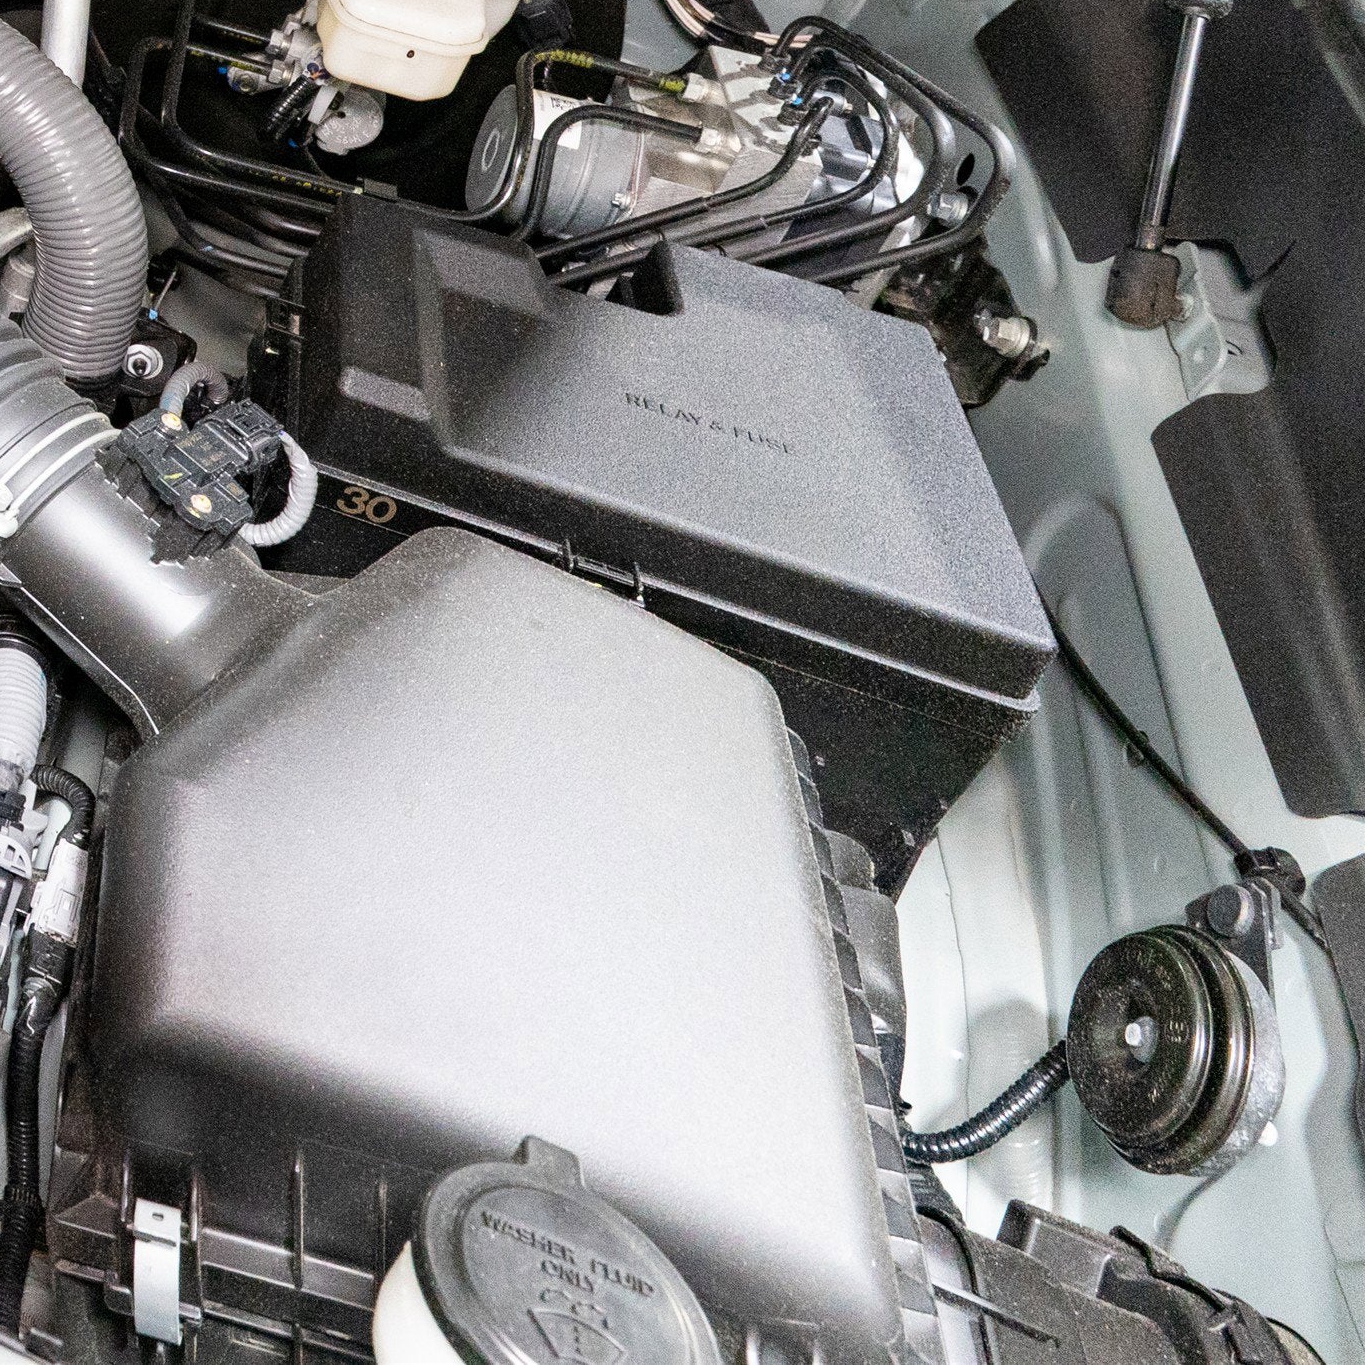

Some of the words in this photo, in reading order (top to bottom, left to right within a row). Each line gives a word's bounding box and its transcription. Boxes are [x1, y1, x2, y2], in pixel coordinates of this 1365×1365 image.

[624, 391, 702, 426] RELAY
[709, 420, 724, 432] &
[732, 426, 797, 455] FUSE
[336, 486, 397, 523] 30
[480, 1210, 576, 1265] WASHER
[590, 1258, 655, 1298] FLUID
[540, 1259, 594, 1293] ONLY
